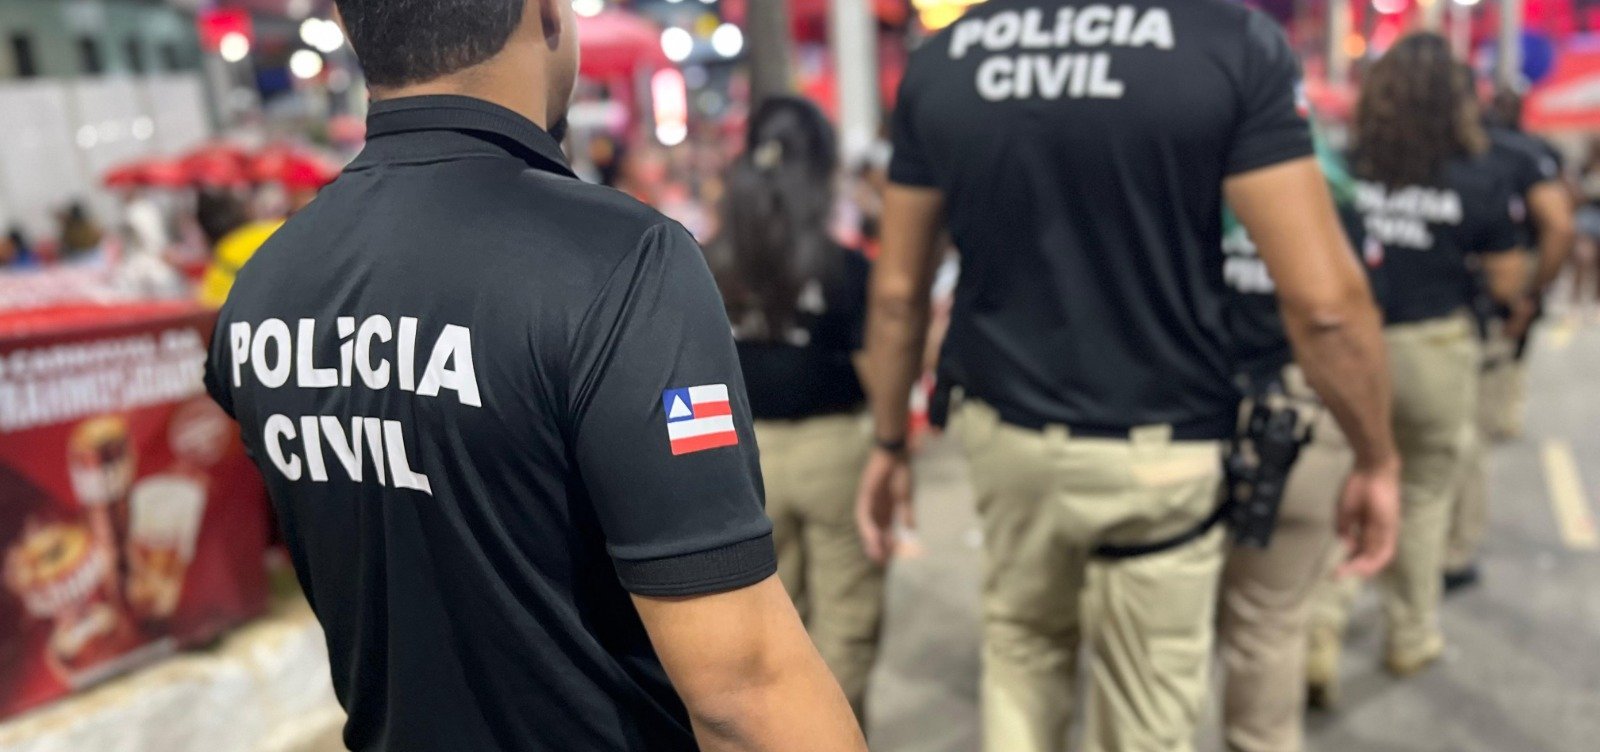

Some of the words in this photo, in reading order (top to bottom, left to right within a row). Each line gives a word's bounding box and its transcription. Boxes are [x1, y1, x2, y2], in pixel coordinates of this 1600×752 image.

[976, 52, 1125, 100] CIVIL
[230, 314, 482, 407] POLÍCIA
[263, 413, 433, 496] CIVIL
